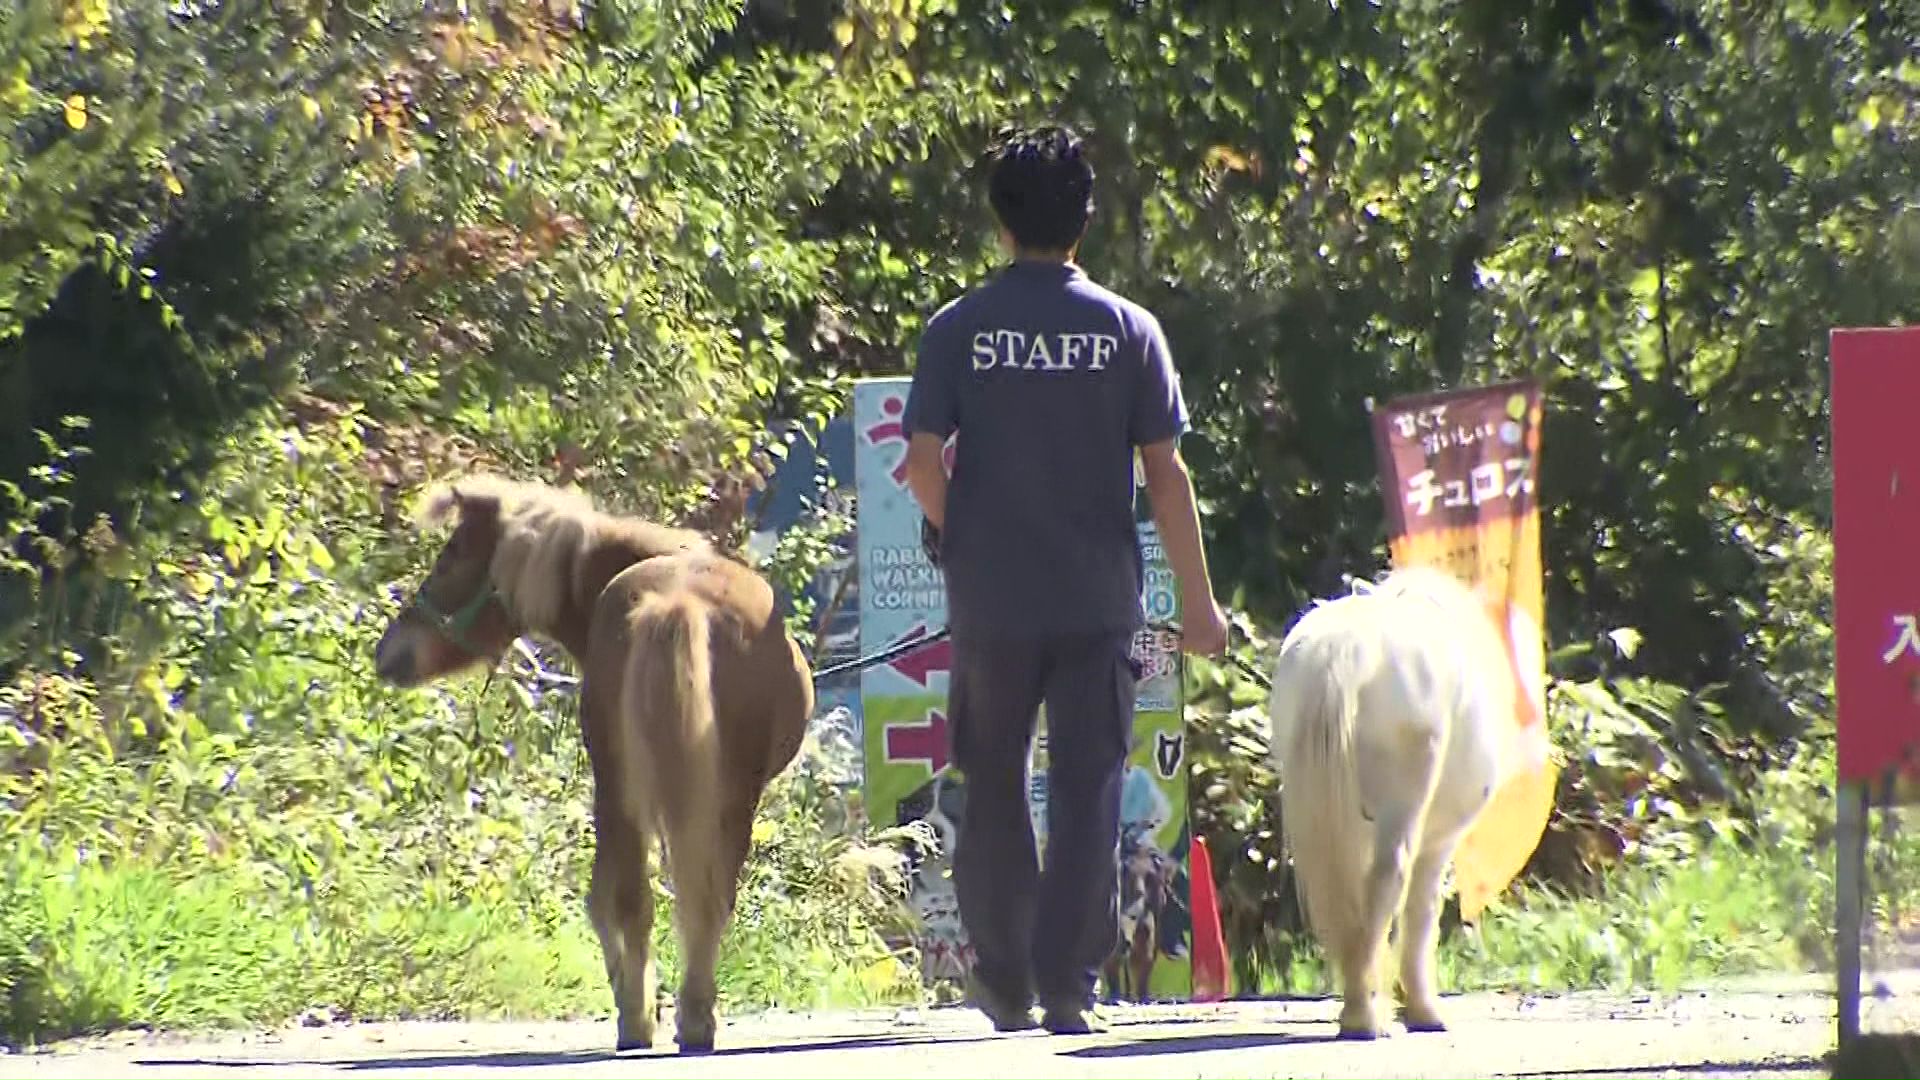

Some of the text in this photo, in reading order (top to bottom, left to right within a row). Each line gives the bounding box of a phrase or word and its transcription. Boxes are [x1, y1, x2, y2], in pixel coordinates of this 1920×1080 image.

[972, 328, 1118, 372] STAFF
[1406, 458, 1536, 516] チュロス
